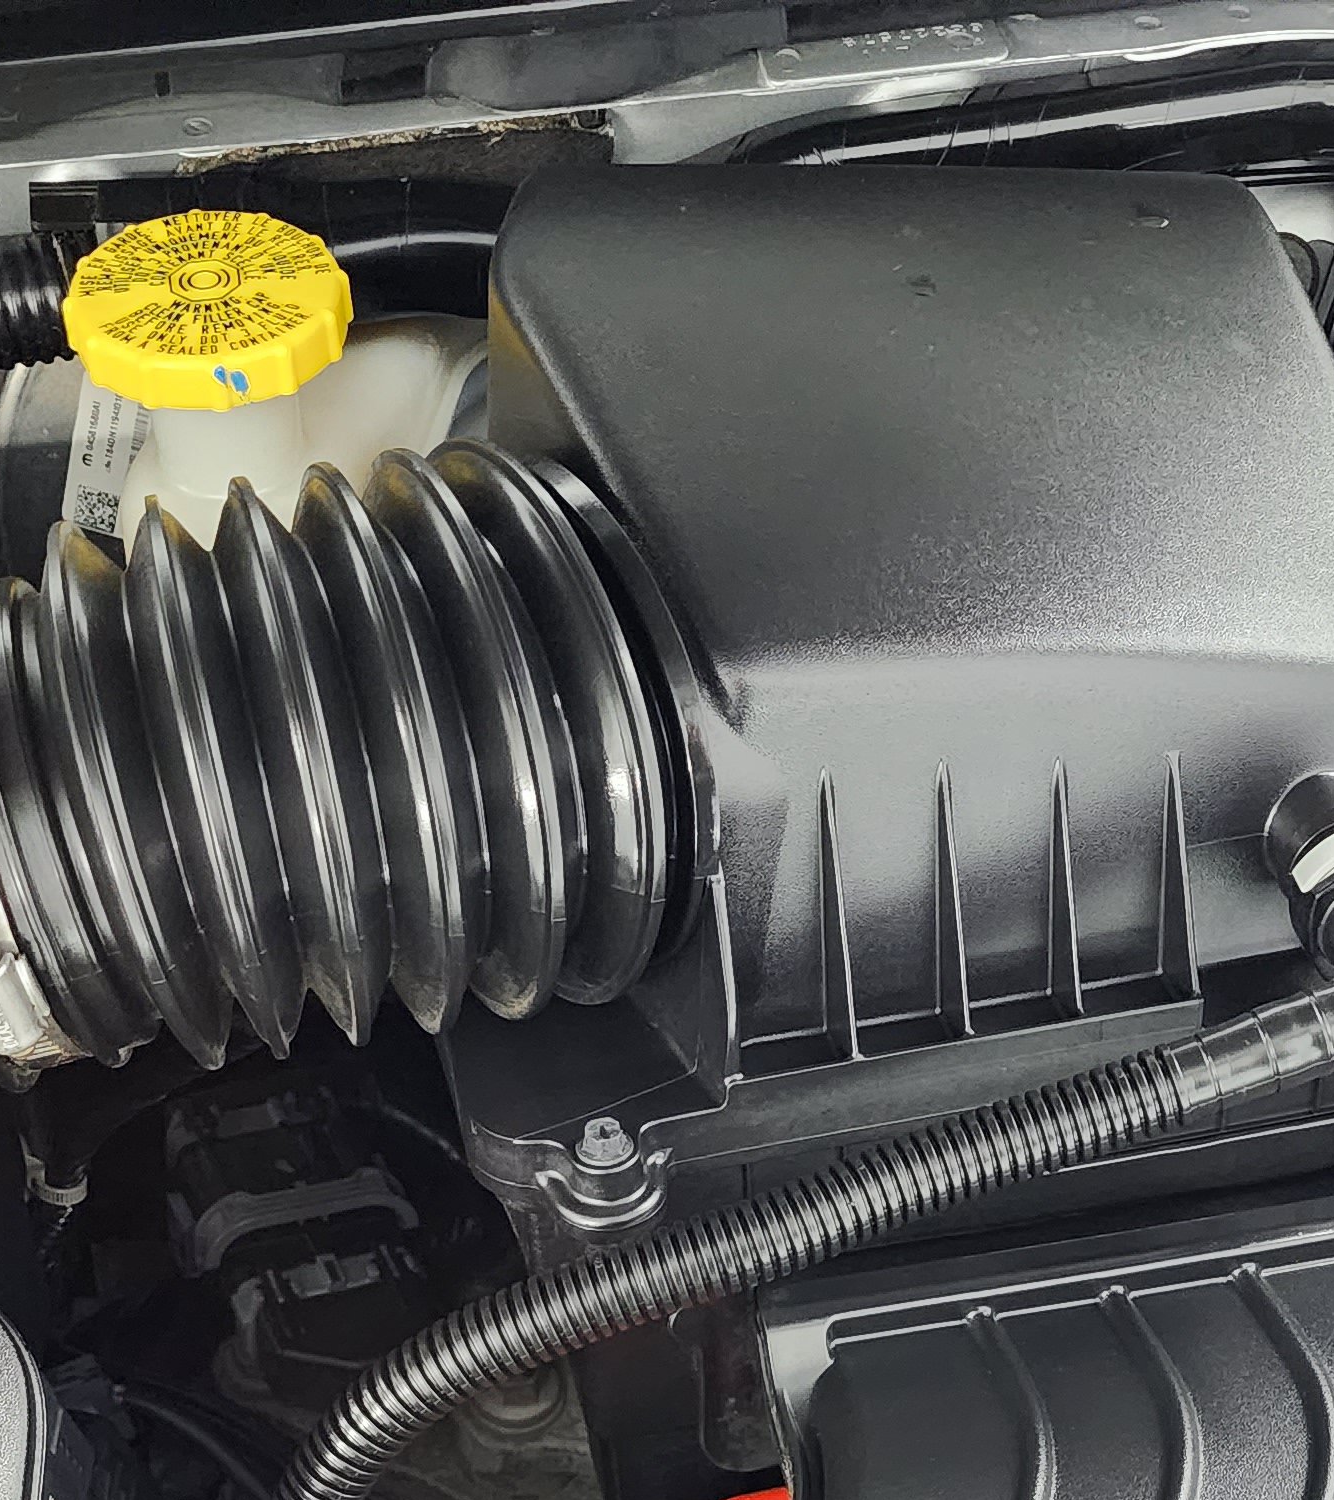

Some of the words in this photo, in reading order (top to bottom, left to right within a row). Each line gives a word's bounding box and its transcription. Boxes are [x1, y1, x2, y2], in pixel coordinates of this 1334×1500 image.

[162, 212, 242, 227] NETTOYER
[252, 215, 272, 228] LE
[276, 224, 325, 259] BOUCHON
[313, 262, 332, 275] DE
[166, 223, 212, 238] AVANT
[222, 222, 242, 232] DE
[247, 226, 268, 238] LE
[131, 266, 154, 282] DOT
[161, 241, 252, 258] PROVENANT
[142, 232, 241, 255] UNIQUEMENT
[244, 236, 265, 248] DU
[263, 245, 297, 280] LIQUIDE
[148, 250, 215, 287] CONTENANT
[114, 316, 143, 335] USE
[146, 331, 188, 345] ONLY
[200, 332, 229, 345] DOT
[239, 328, 252, 338] 3
[257, 303, 301, 331] FLUID
[128, 309, 188, 335] BEFORE
[143, 302, 186, 323] CLEAN
[192, 307, 246, 325] FILLER
[245, 291, 270, 309] CAP
[98, 322, 138, 345] FROM
[137, 340, 150, 350] A
[156, 343, 219, 356] SEALED
